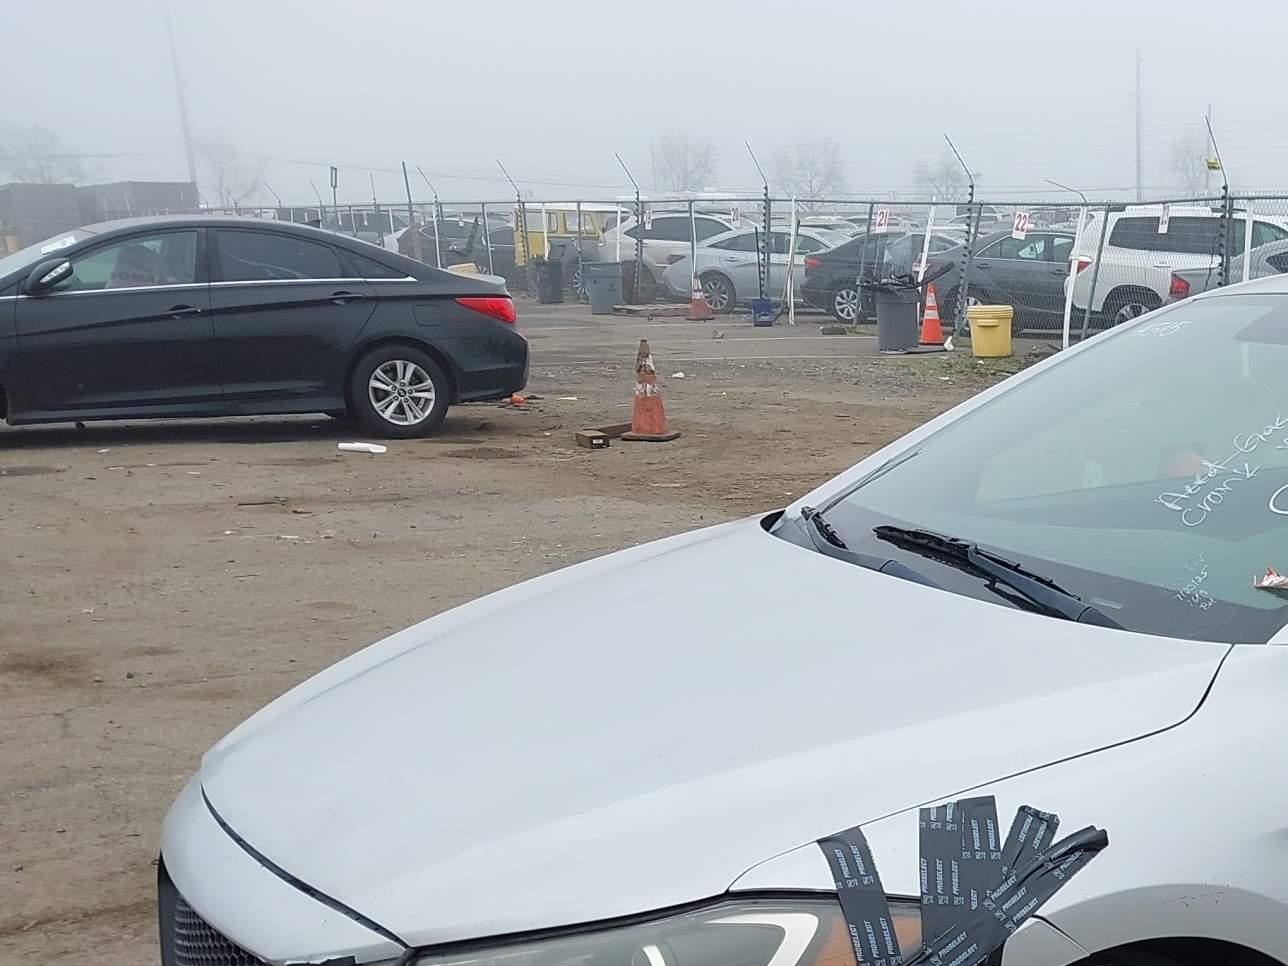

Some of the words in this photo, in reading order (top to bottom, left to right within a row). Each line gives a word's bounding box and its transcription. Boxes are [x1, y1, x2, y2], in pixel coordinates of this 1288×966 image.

[878, 211, 888, 227] 21
[1015, 213, 1028, 232] 22
[971, 819, 980, 850] PROSELECT
[987, 819, 996, 850] PROSELECT
[834, 849, 852, 879] PROSELECT
[850, 844, 867, 875] PROSELECT
[936, 858, 944, 894] PROSELECT
[952, 859, 960, 895] PROSELECT
[991, 875, 1017, 901] PROSELECT
[1002, 887, 1028, 912] PROSELECT
[1013, 897, 1039, 923] PROSELECT
[849, 924, 864, 962] PROSELECT
[864, 920, 880, 958] PROSELECT
[880, 917, 895, 955] PROSELECT
[938, 931, 968, 959] PROSELECT
